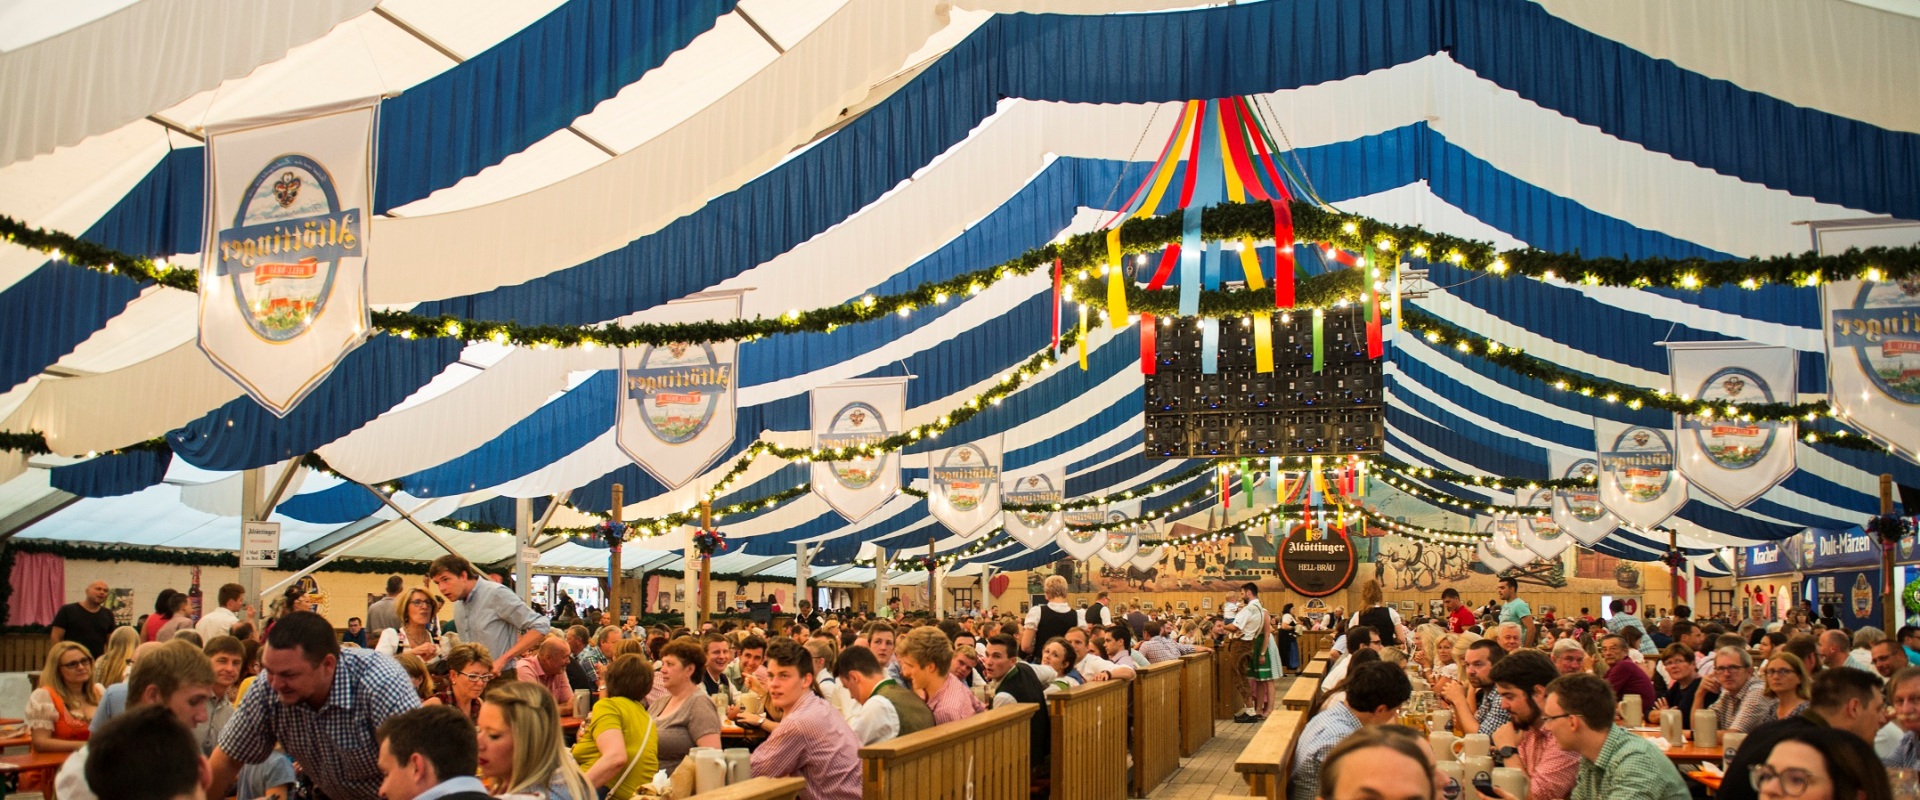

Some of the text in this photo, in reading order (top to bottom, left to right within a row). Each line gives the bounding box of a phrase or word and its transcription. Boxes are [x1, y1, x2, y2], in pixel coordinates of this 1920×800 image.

[1288, 541, 1345, 555] Altöttinger
[1819, 532, 1870, 556] Dult-Märzen
[1298, 563, 1336, 571] HELL-BRÄU
